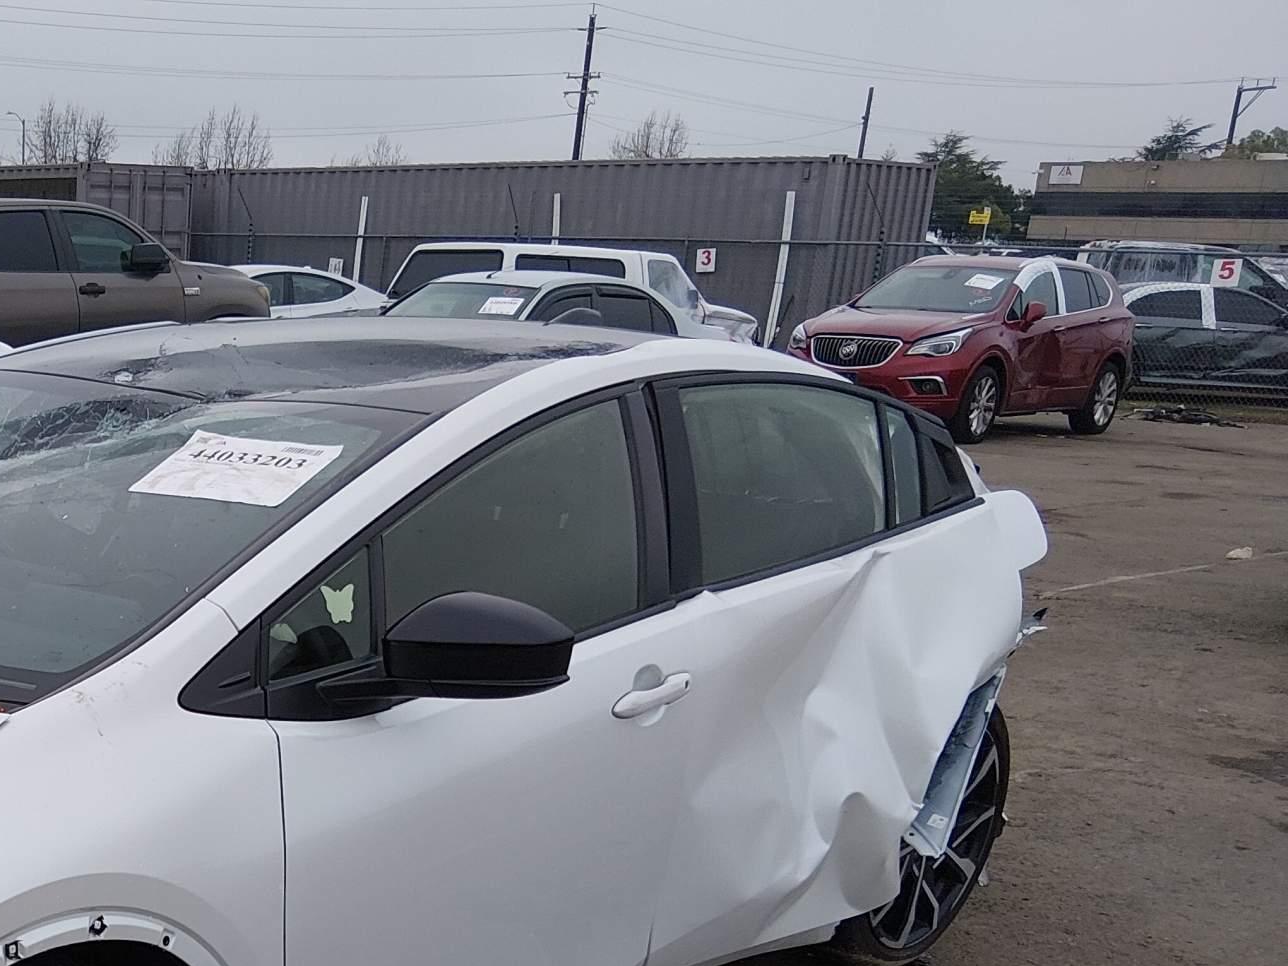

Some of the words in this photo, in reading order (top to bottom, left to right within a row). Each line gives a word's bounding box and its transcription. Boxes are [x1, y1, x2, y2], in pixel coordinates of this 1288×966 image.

[700, 250, 712, 266] 3
[1218, 260, 1236, 280] 5
[188, 448, 308, 470] 44033203
